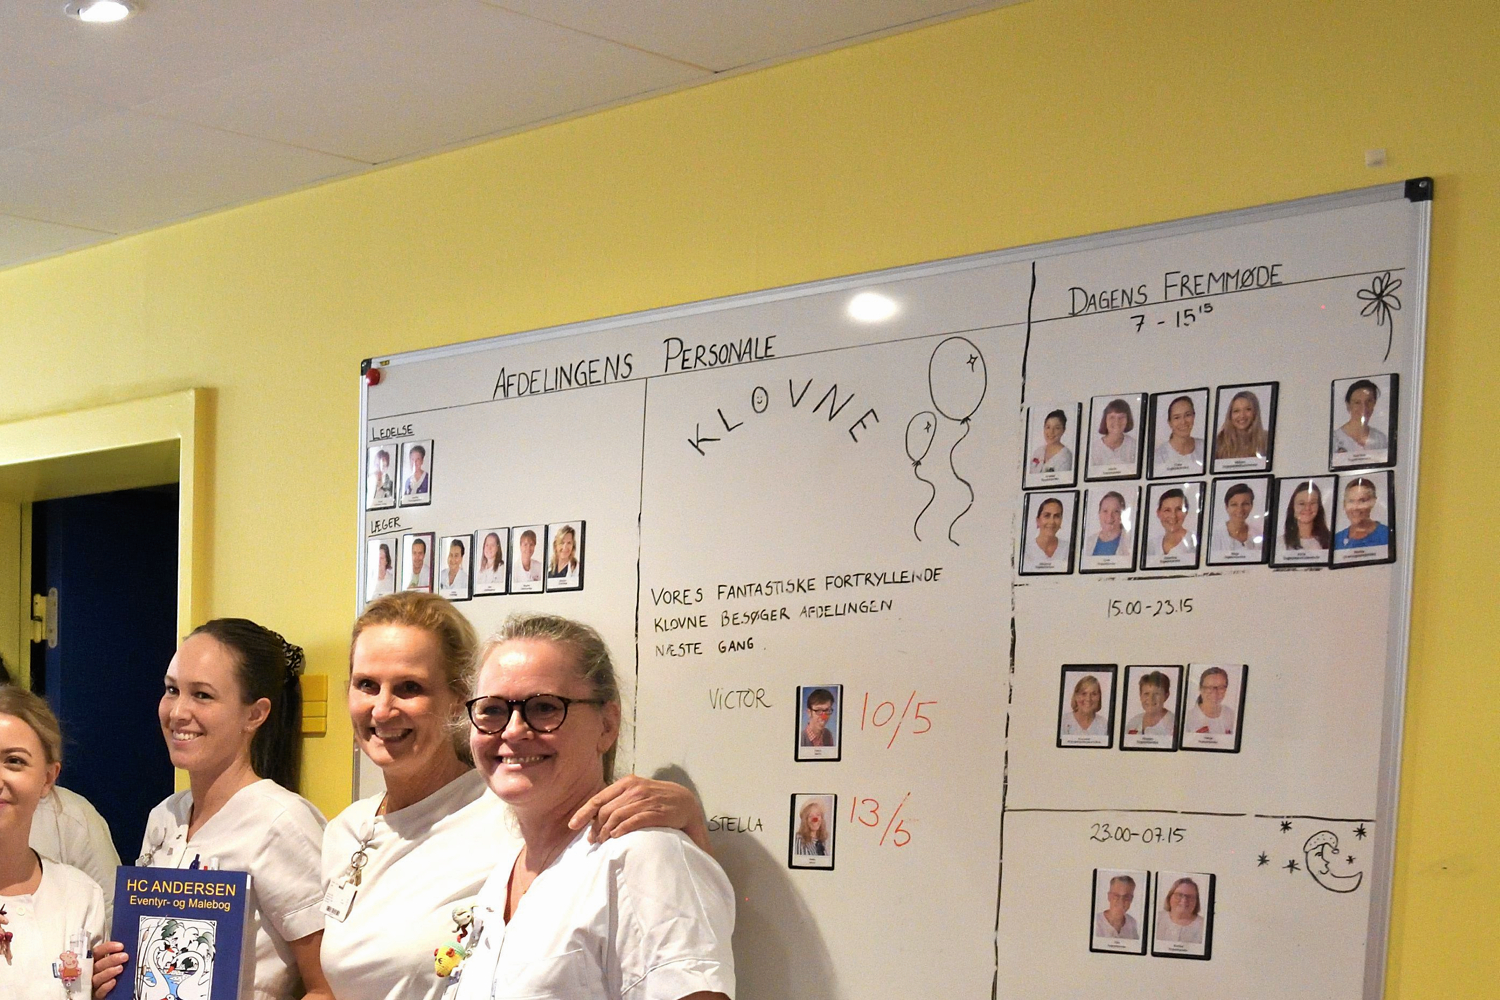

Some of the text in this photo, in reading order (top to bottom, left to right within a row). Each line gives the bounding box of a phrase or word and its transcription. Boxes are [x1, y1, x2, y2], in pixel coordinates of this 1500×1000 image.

[1068, 264, 1283, 317] DAGENS FREMMØDE
[1130, 315, 1145, 333] 7
[492, 335, 777, 399] AFDELINGENS PERSONALE
[687, 377, 880, 456] KLOVNE
[371, 423, 415, 440] LEDELSE
[651, 567, 944, 606] VORES FANTASTISKE FORTRYLLENDE
[654, 614, 709, 633] KLOVNE
[799, 599, 894, 619] AFDELINGEN
[655, 642, 703, 657] NÆSTE
[707, 816, 764, 834] STELLA
[126, 879, 237, 897] HC ANDERSEN
[129, 895, 231, 912] Eventyr- og Malebog
